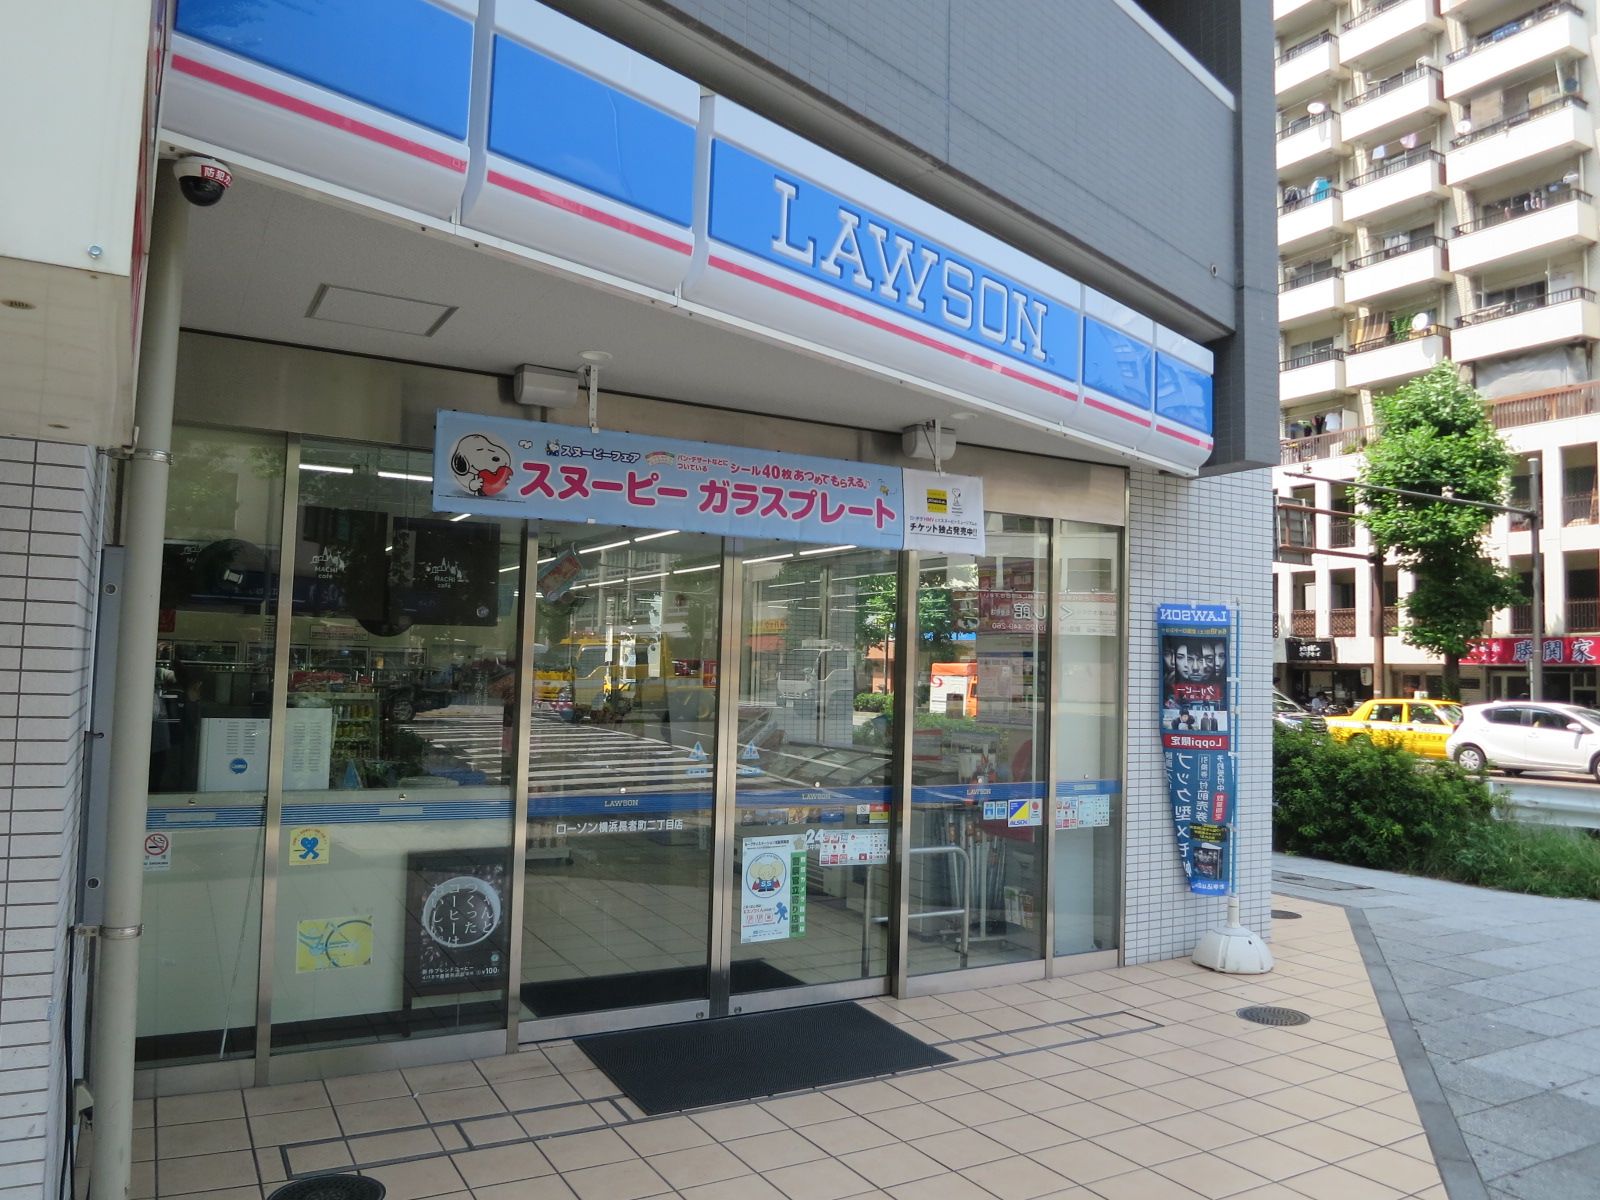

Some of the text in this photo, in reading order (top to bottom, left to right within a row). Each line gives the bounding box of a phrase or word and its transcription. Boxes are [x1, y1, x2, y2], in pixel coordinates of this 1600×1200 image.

[771, 175, 1047, 362] LAWSON
[561, 446, 640, 463] スヌーピーフェア
[519, 461, 688, 507] スヌーピー
[698, 480, 897, 529] ガラスプレート
[434, 575, 456, 583] MACHI
[604, 799, 639, 807] LAWSON
[556, 819, 684, 835] ローソン横浜長者町二丁目店
[806, 829, 824, 844] 24
